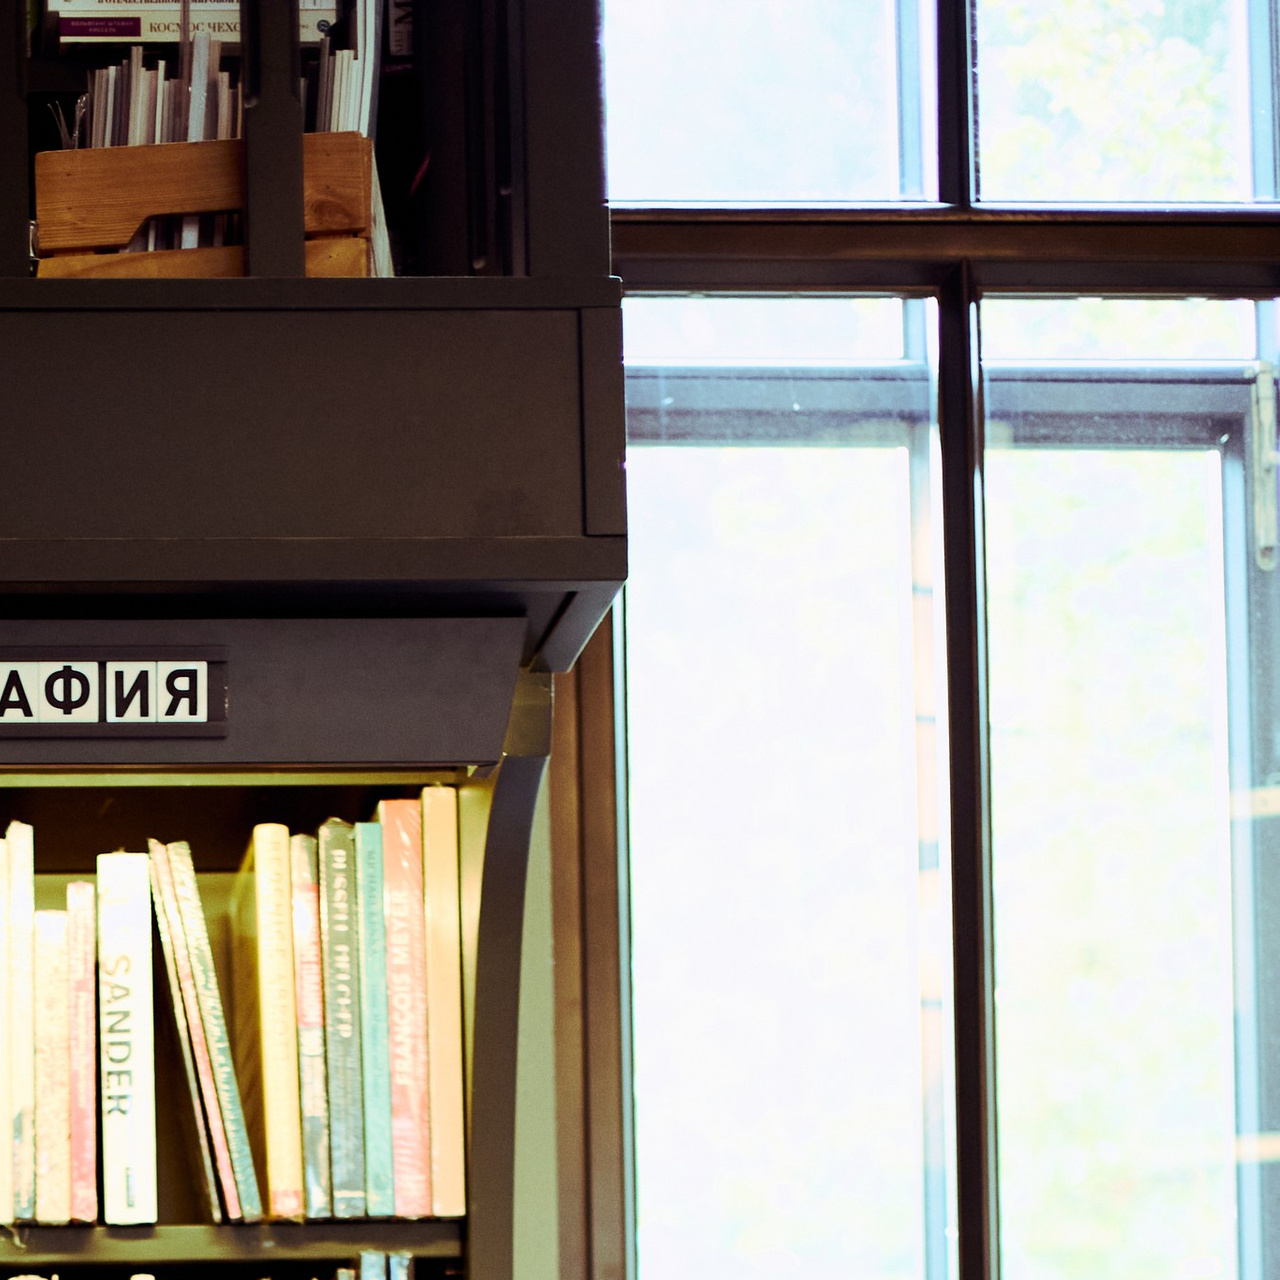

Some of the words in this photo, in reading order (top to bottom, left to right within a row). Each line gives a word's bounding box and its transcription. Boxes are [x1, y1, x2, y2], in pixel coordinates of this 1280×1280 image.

[391, 888, 412, 965] MEYER
[105, 954, 133, 1118] SANDER
[393, 973, 414, 1086] FRANÇOIS
